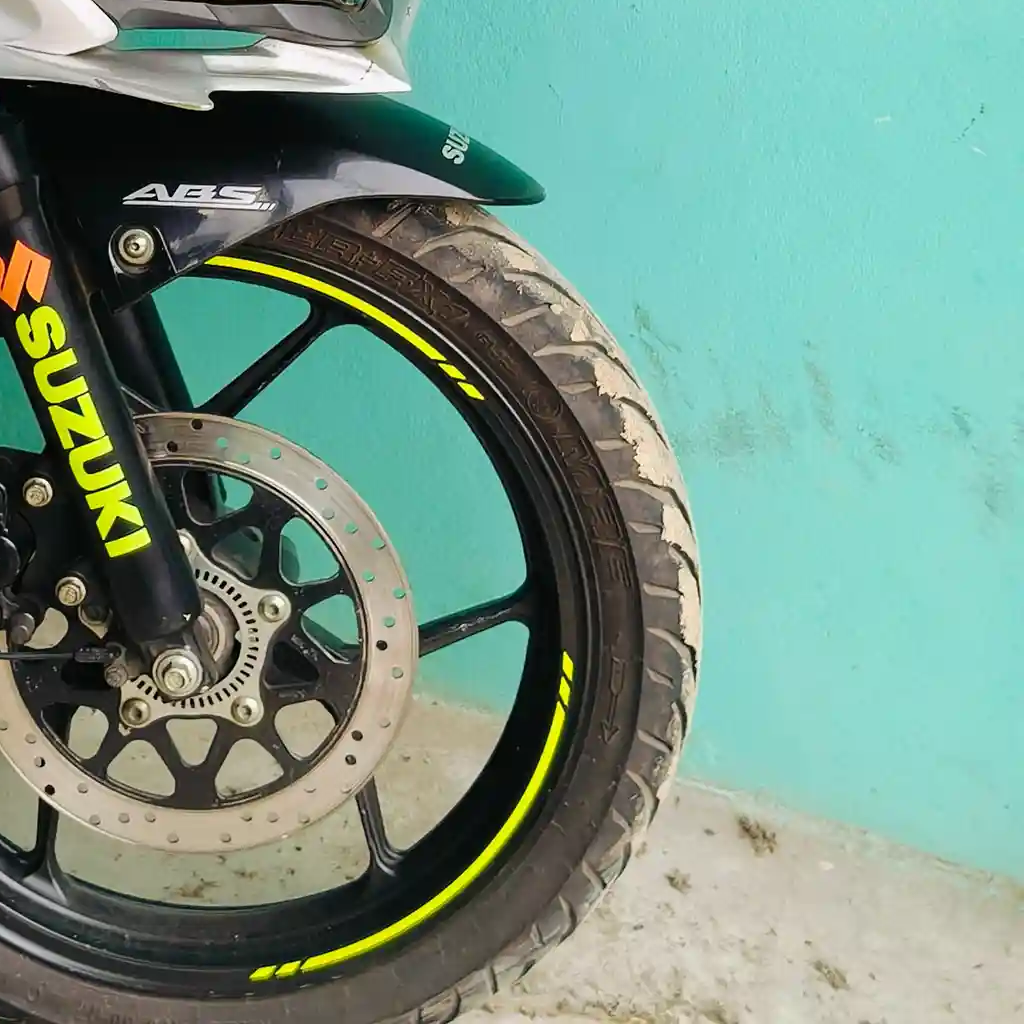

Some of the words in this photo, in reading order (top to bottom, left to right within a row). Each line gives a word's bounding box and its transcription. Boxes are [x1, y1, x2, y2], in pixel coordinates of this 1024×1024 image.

[441, 126, 470, 165] SUZ
[123, 183, 264, 204] ABS
[15, 305, 152, 558] SUZUKI
